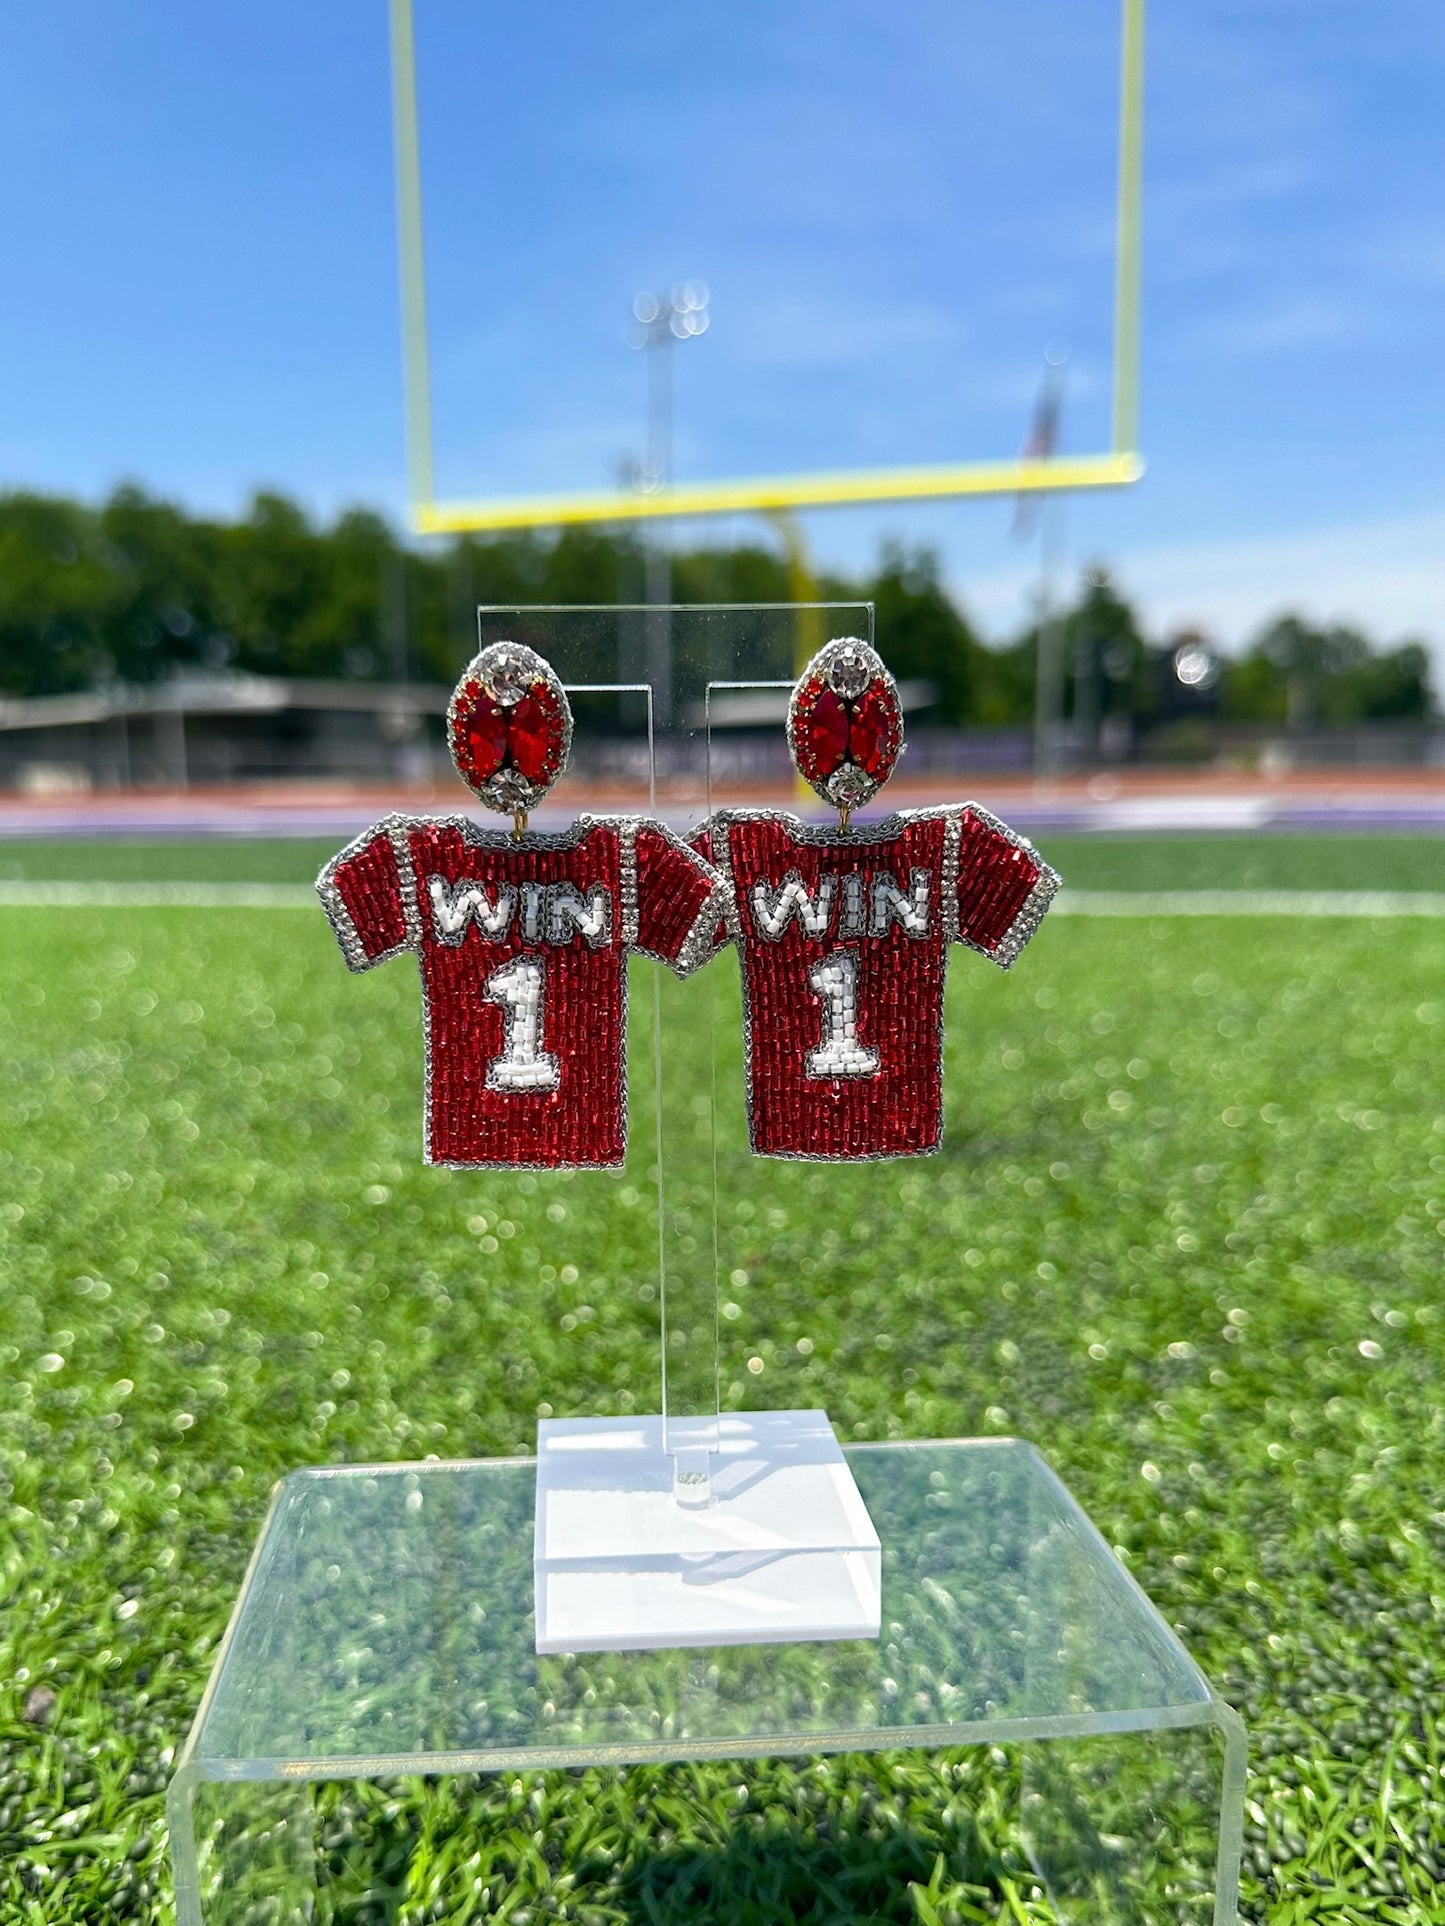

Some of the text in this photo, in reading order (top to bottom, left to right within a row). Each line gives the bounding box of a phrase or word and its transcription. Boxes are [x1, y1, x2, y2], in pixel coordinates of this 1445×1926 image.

[427, 876, 611, 946] WIN
[750, 869, 931, 940] WIN
[485, 958, 559, 1092] 1
[807, 953, 879, 1078] 1
